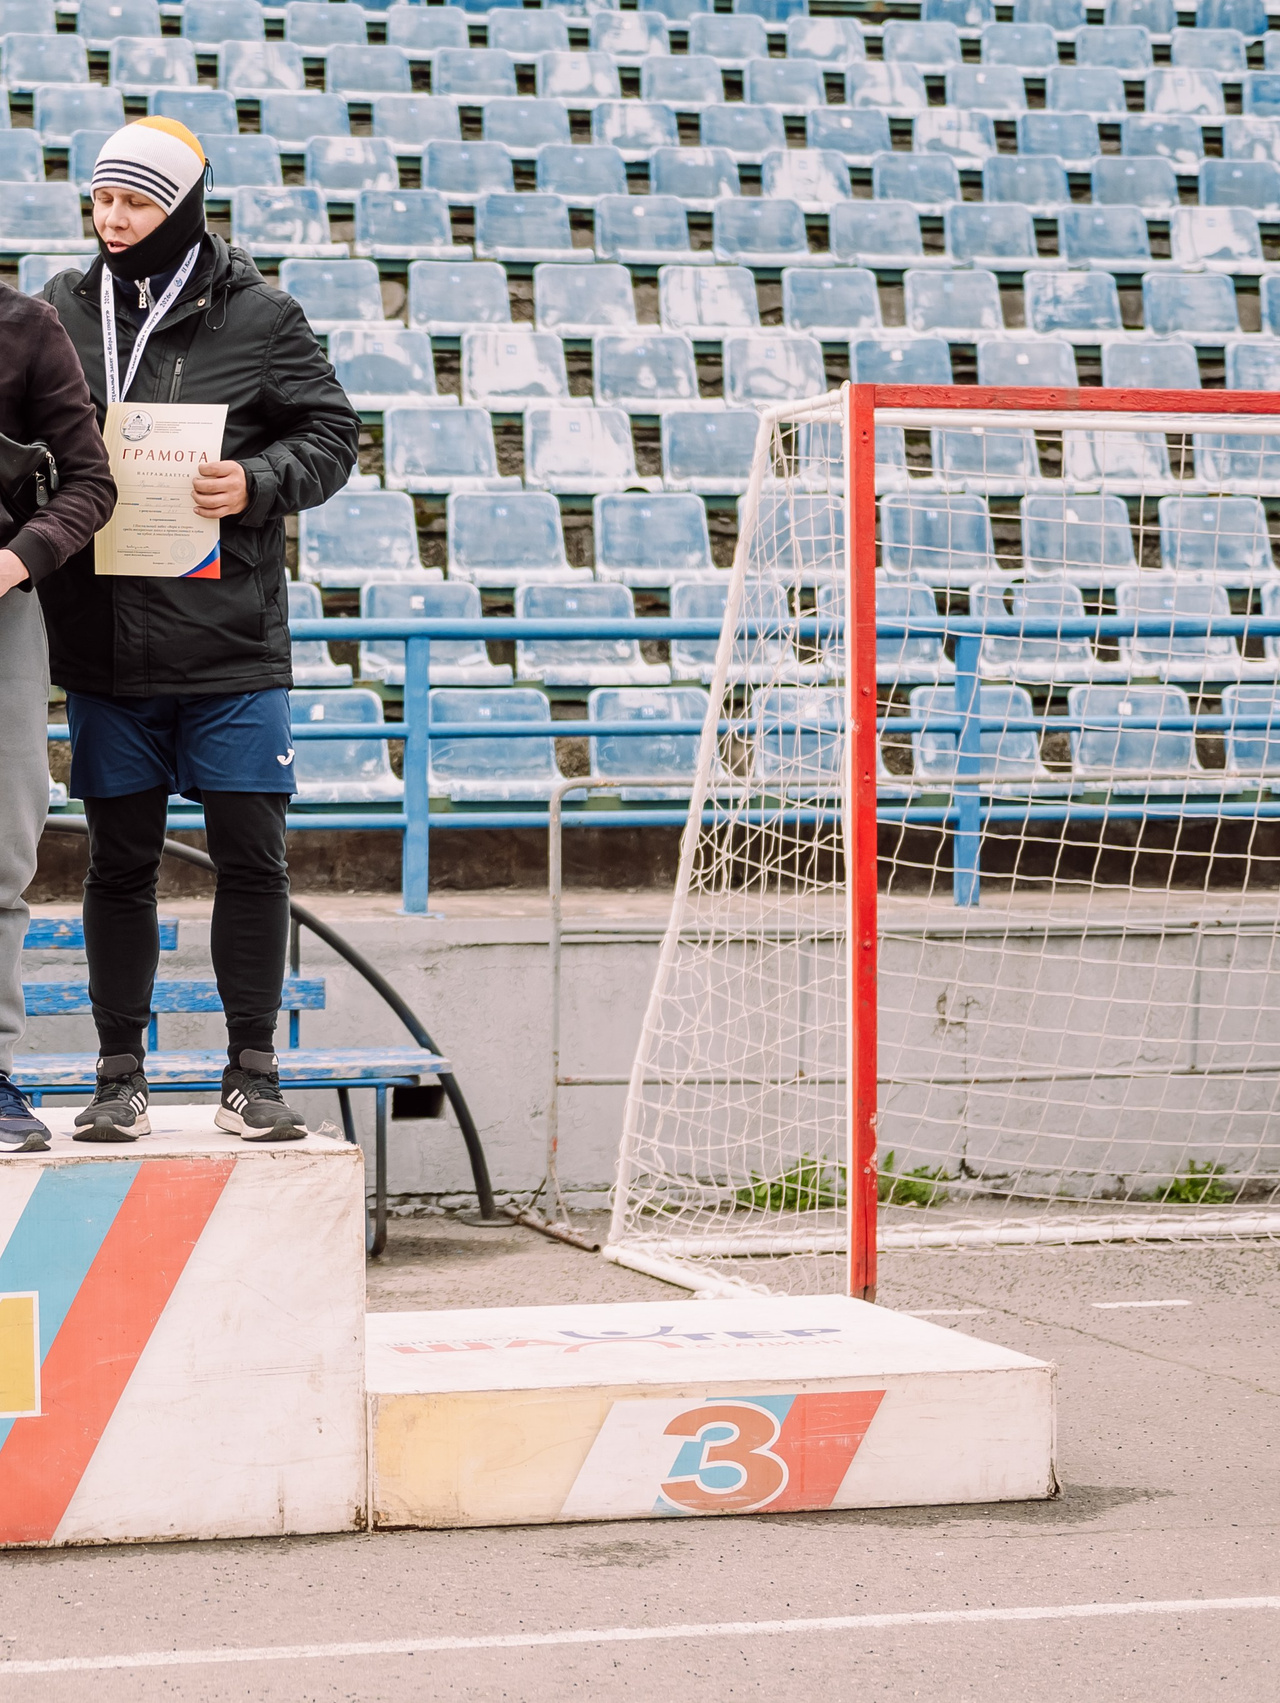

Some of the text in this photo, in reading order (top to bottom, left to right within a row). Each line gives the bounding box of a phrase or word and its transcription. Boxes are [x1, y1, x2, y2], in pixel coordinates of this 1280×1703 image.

[122, 448, 209, 464] ГРАМОТА
[136, 470, 191, 479] НАГРАЖДАЕТСЯ
[659, 1400, 789, 1512] 3
